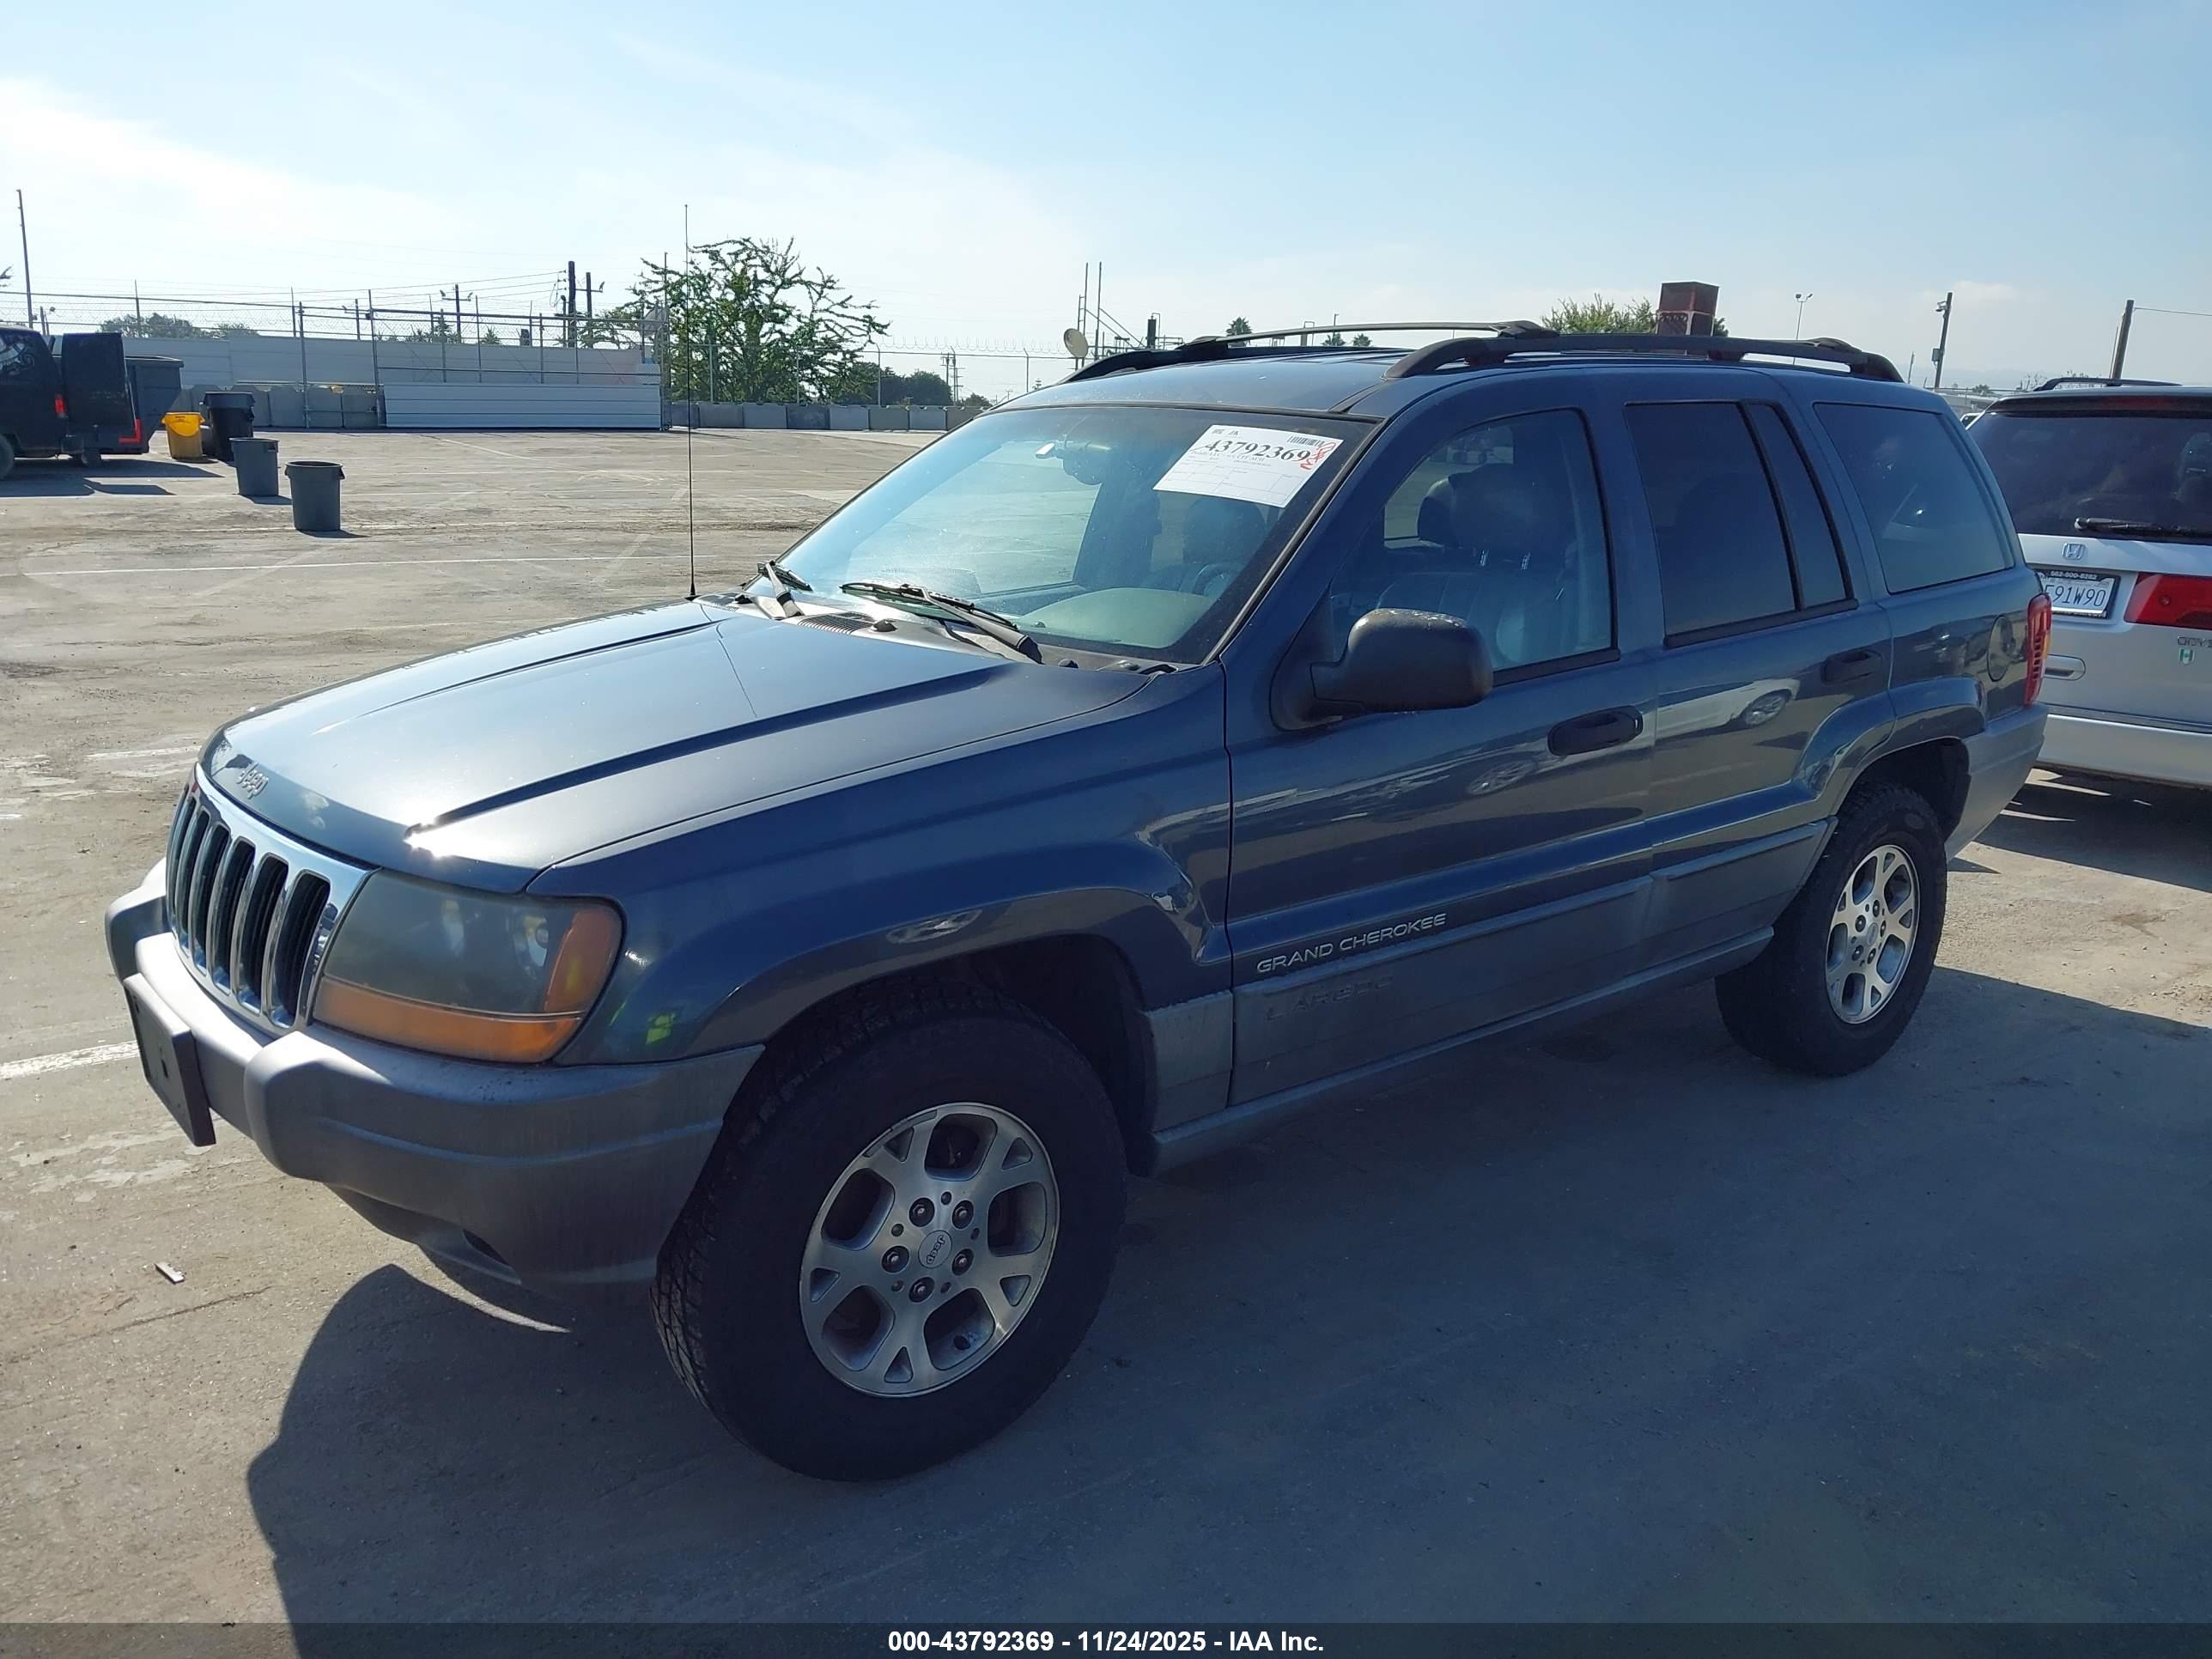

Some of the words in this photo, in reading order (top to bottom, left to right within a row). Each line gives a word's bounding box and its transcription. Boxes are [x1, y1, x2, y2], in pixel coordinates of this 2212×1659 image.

[1205, 439, 1311, 462] 43792369
[1256, 943, 1334, 974] GRAND
[1339, 913, 1447, 951] CHEROKEE
[926, 1235, 945, 1265] Jeep
